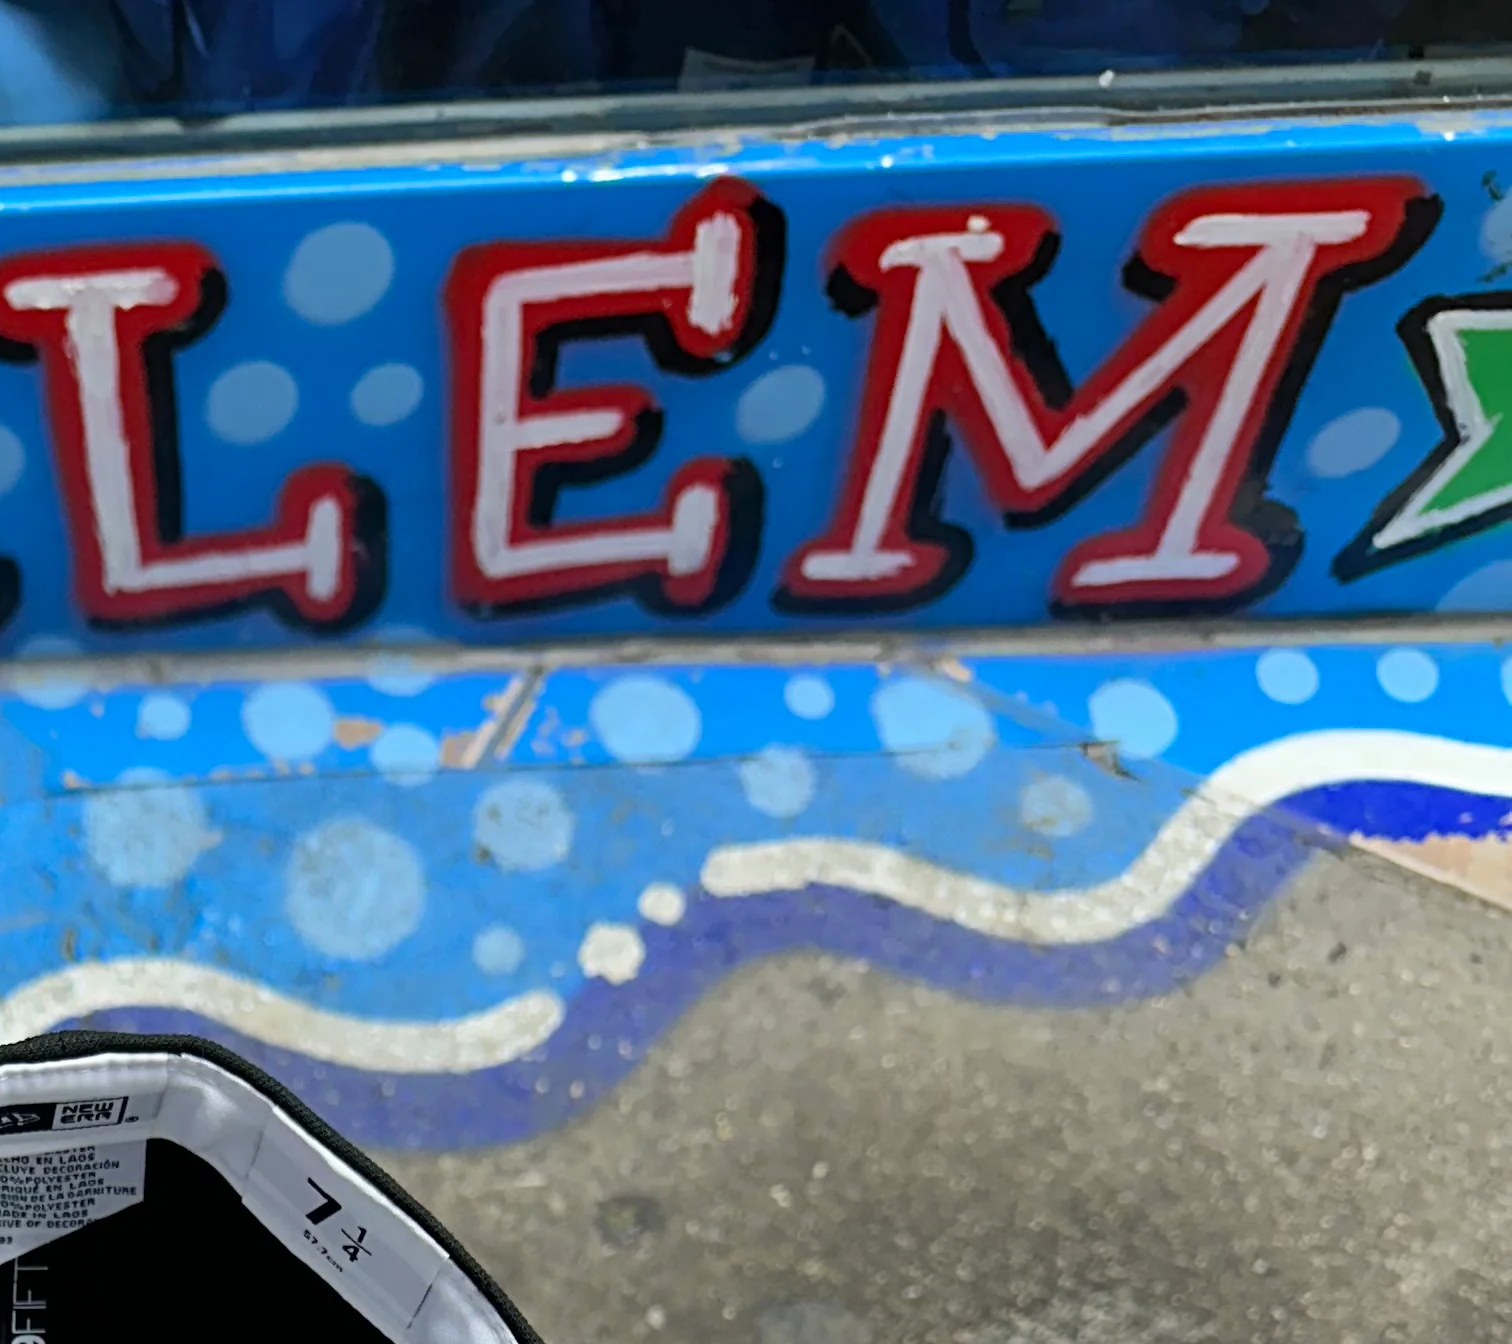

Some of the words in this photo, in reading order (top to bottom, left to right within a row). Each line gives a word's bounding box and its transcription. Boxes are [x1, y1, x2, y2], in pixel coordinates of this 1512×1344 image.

[62, 1102, 113, 1114] NEW
[60, 1113, 111, 1124] ERA
[36, 1157, 53, 1165] EN
[59, 1153, 96, 1165] LAOS
[44, 1160, 120, 1174] DECORACIÓN
[46, 1184, 63, 1192] EN
[69, 1178, 104, 1189] LAOS
[305, 1177, 342, 1225] 7
[53, 1210, 88, 1219] LAOS
[26, 1220, 42, 1228] OF
